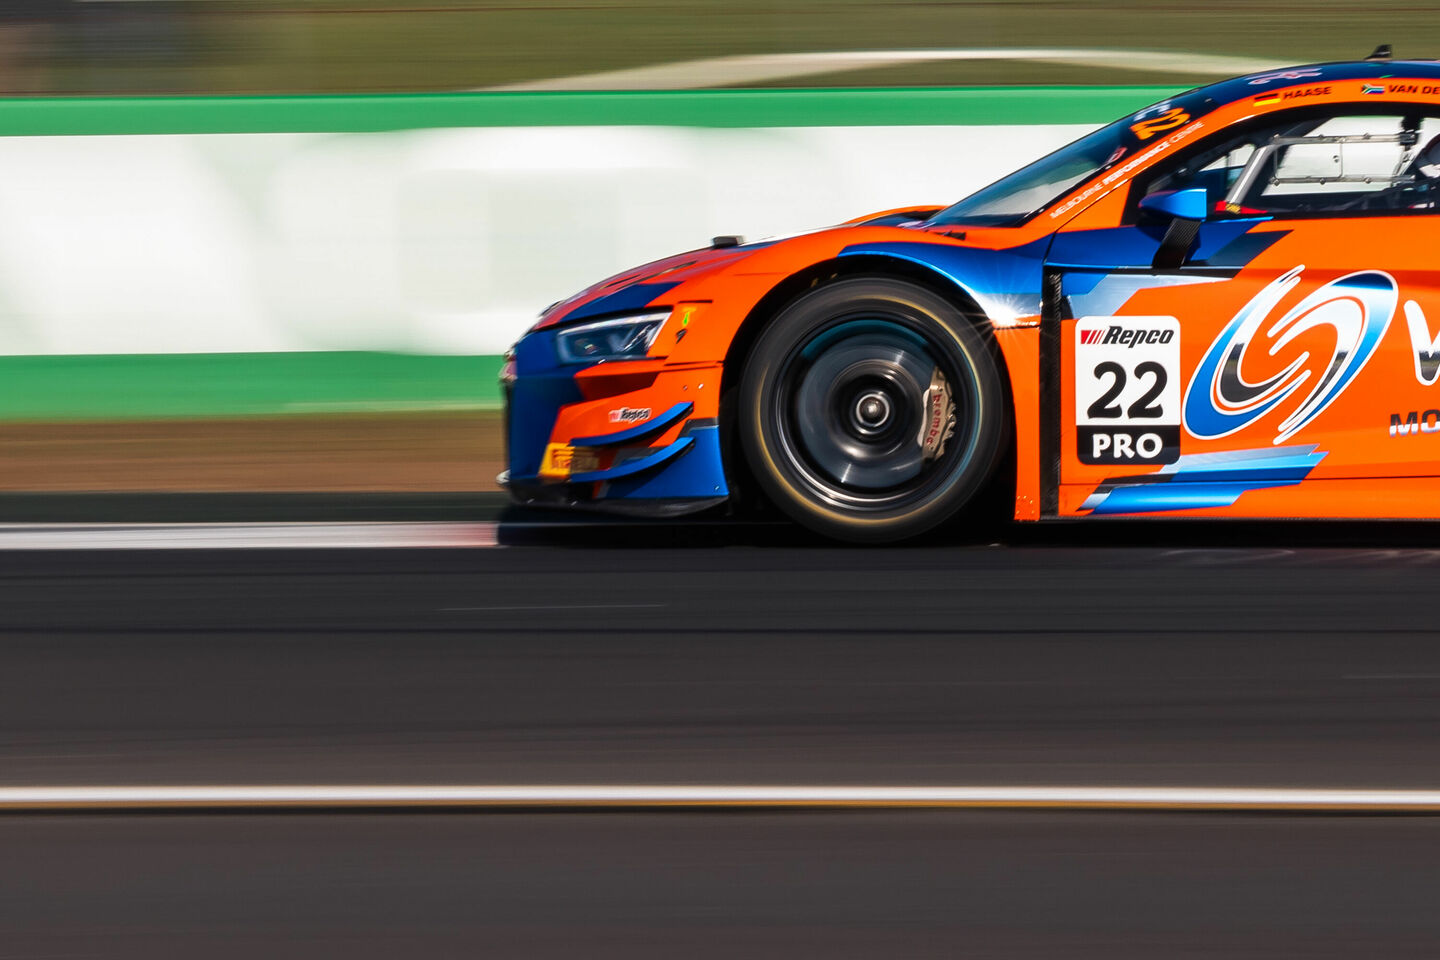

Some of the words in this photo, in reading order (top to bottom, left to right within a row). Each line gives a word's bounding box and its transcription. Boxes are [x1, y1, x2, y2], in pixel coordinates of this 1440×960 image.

[1284, 86, 1332, 100] HAASE
[1388, 85, 1418, 94] VAN
[1102, 141, 1171, 186] PERFORMANCE
[1102, 326, 1174, 348] Repco
[1087, 361, 1168, 419] 22
[926, 394, 942, 445] brembo
[1092, 432, 1163, 459] PRO
